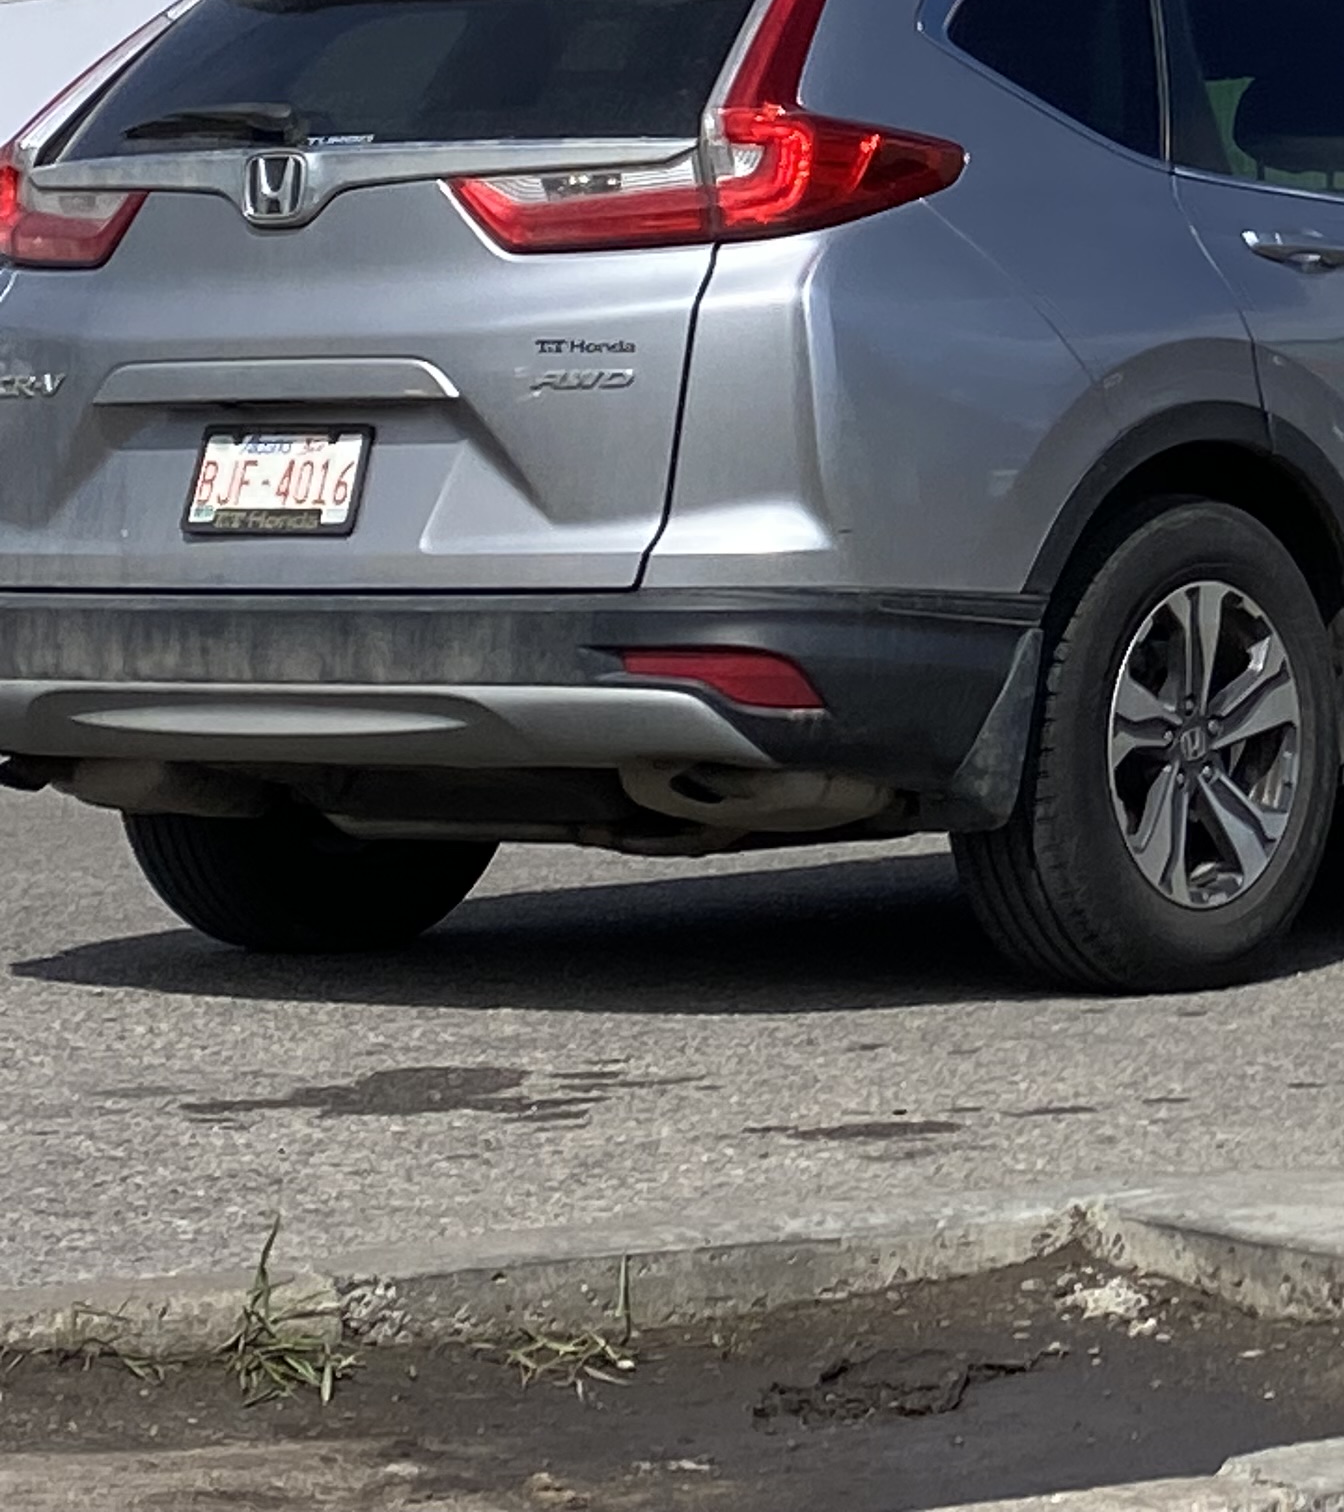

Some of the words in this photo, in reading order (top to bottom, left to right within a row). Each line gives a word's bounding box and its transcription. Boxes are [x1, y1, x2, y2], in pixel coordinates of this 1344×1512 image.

[569, 339, 636, 354] Honda
[196, 459, 356, 507] BJF-4016
[248, 510, 319, 529] Honda
